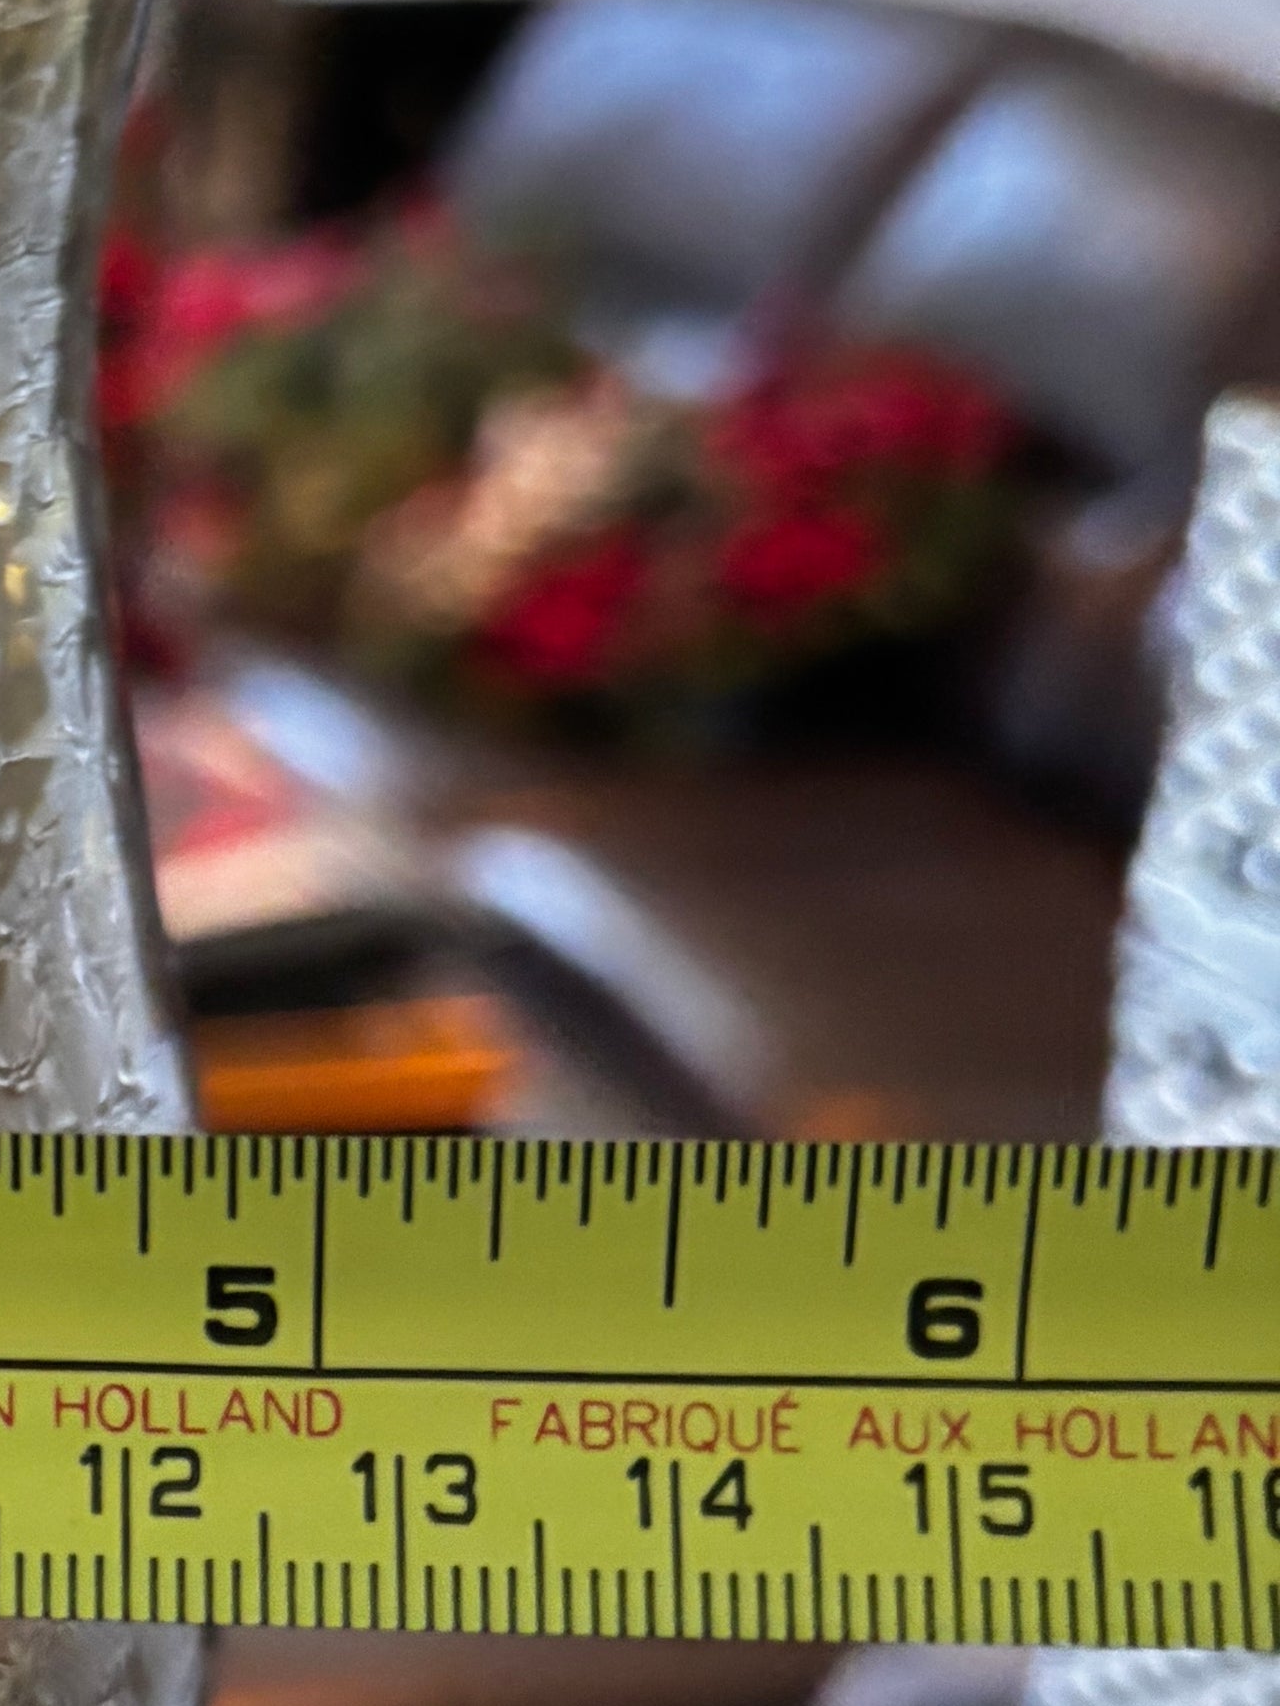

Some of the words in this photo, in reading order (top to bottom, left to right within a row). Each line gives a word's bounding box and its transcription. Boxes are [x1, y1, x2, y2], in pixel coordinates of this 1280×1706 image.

[204, 1265, 279, 1346] 5
[907, 1279, 983, 1360] 6
[54, 1383, 345, 1439] HOLLAND
[491, 1390, 801, 1454] FABRIQUÉ
[848, 1404, 972, 1452] AUX
[80, 1444, 202, 1518] 12
[352, 1452, 478, 1525] 13
[627, 1459, 753, 1532] 14
[904, 1463, 1033, 1537] 15
